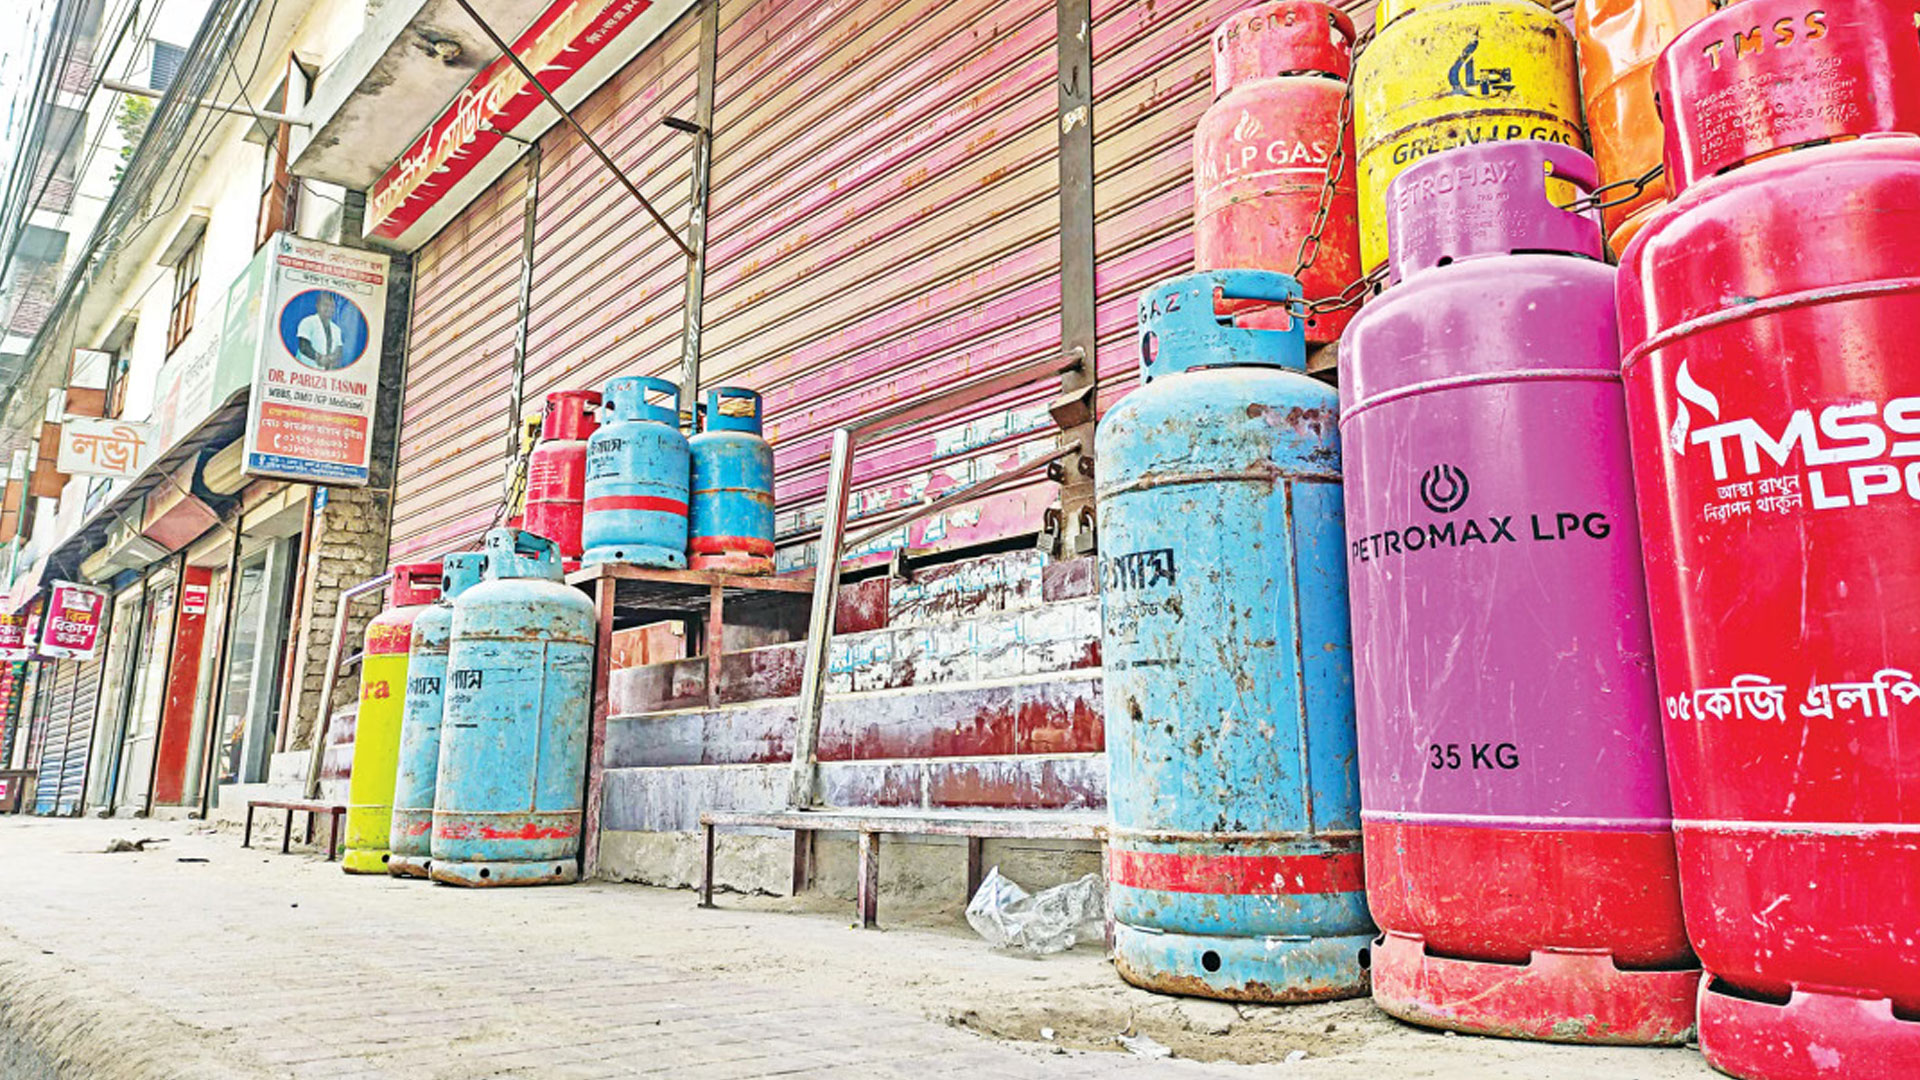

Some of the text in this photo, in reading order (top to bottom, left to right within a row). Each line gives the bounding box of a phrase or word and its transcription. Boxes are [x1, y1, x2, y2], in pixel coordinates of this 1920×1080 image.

[1703, 11, 1827, 71] TMSS
[1266, 140, 1328, 165] GAS
[290, 372, 327, 390] PARIZA
[1691, 397, 1920, 481] TMSS
[1716, 475, 1800, 500] আস্থা রাখুন
[1704, 493, 1803, 522] নিরাপদ থাকুন
[1352, 512, 1611, 565] PETROMAX LPG
[1430, 743, 1520, 770] 35 KG
